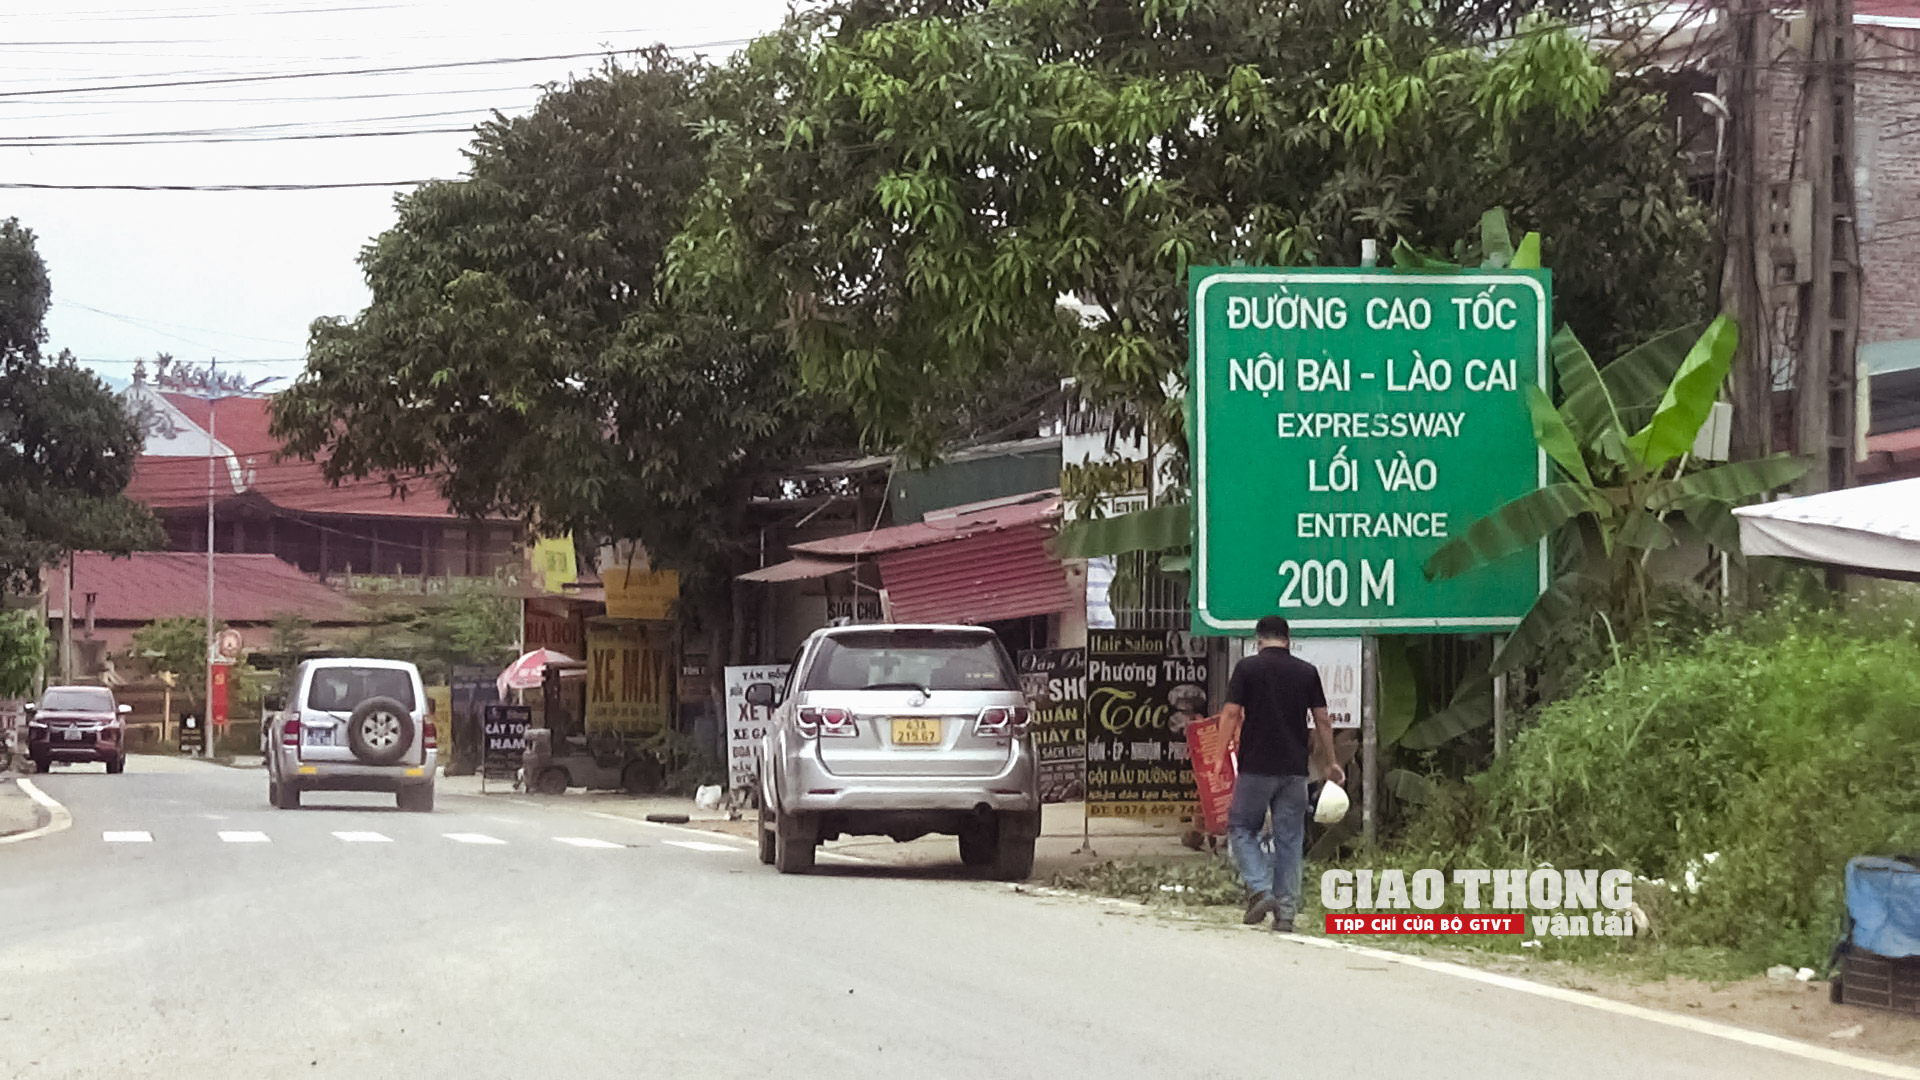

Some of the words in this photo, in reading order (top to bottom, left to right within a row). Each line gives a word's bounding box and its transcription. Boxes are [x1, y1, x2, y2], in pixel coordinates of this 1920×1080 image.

[1227, 285, 1347, 330] ĐƯỜNG
[1366, 298, 1432, 330] CAO
[1452, 284, 1518, 330] TỐC
[1229, 352, 1284, 398] NỘI
[1387, 350, 1451, 391] LÀO
[1465, 359, 1517, 391] CAI
[1277, 412, 1465, 438] EXPRESSWAY
[1309, 445, 1358, 492] LỐI
[1375, 450, 1438, 492] VÀO
[1297, 512, 1448, 538] ENTRANCE
[1278, 559, 1348, 608] 200
[1361, 559, 1395, 606] M
[1090, 634, 1121, 653] Hair
[1124, 635, 1164, 653] Salon
[592, 648, 616, 702] XE
[1088, 660, 1157, 688] Phương
[1162, 657, 1208, 682] Thảo
[1087, 686, 1169, 735] Tóc
